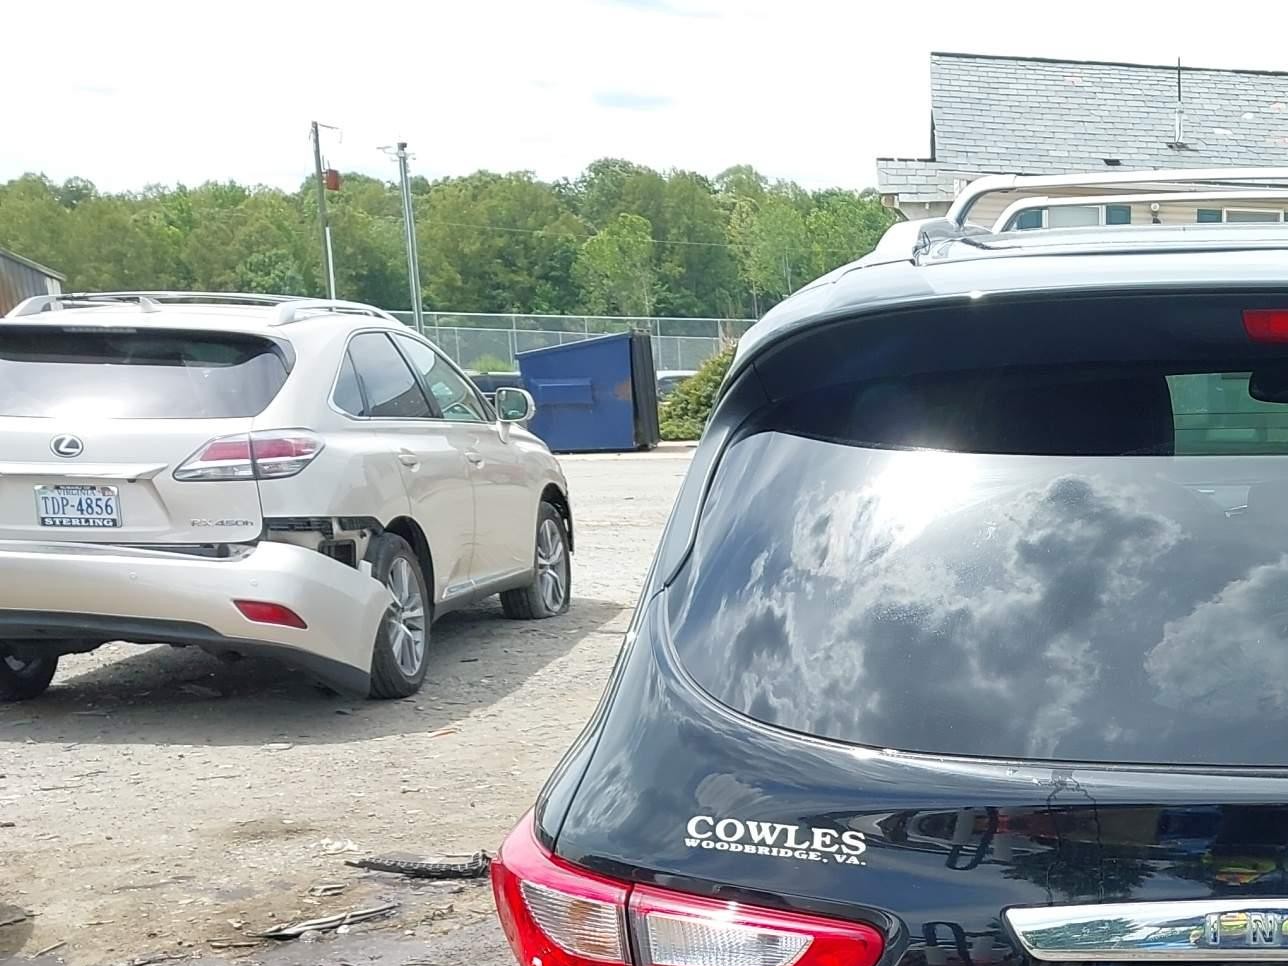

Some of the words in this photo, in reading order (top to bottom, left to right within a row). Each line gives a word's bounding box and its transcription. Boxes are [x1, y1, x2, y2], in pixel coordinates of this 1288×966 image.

[42, 496, 114, 515] TDP-4856
[44, 517, 114, 527] STERLING
[686, 815, 867, 855] COWLES
[834, 854, 867, 866] VA.
